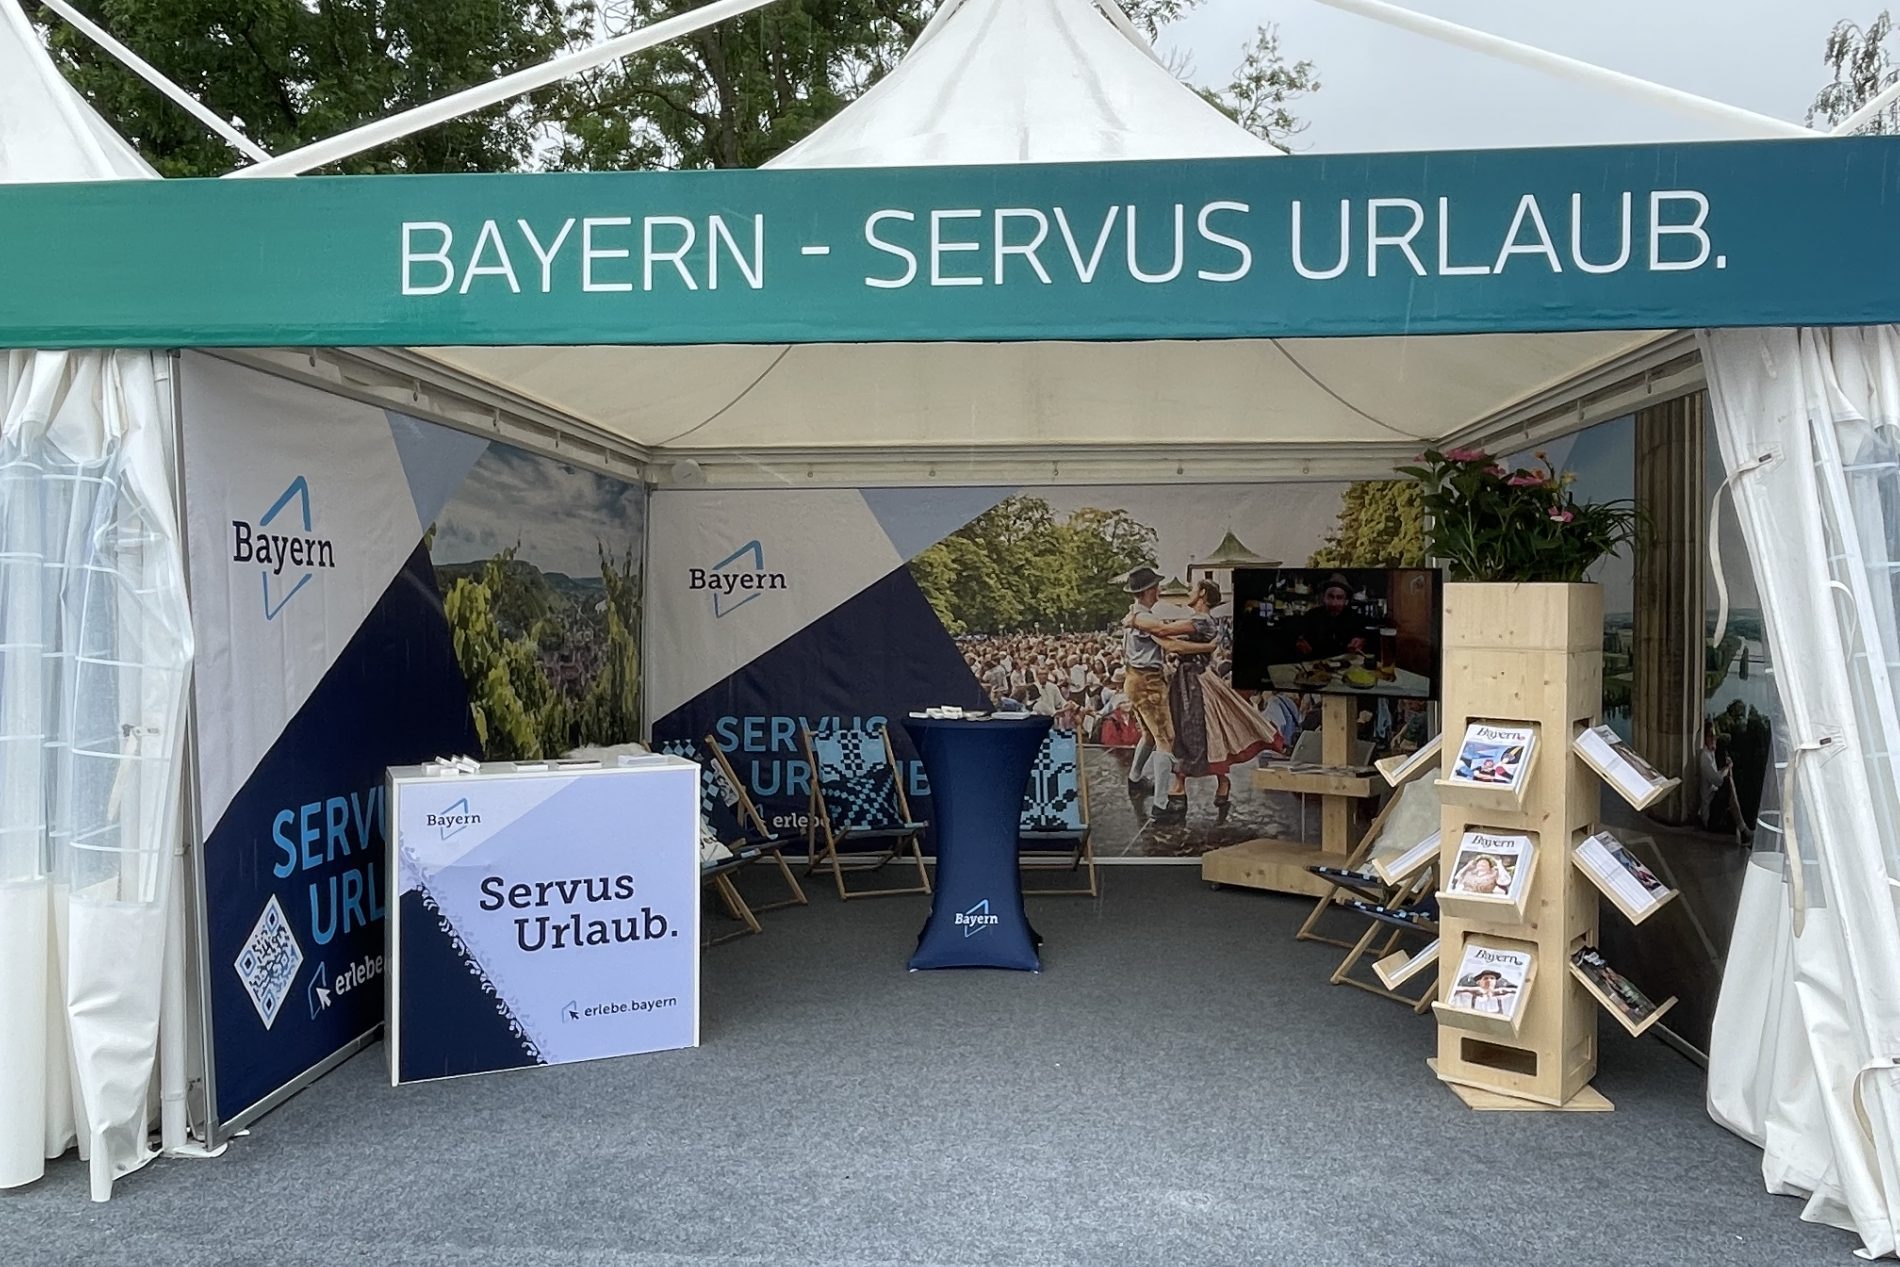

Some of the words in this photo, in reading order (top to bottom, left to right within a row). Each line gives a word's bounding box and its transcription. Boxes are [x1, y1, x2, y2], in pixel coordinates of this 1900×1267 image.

[401, 214, 764, 296] BAYERN
[801, 246, 830, 255] -
[864, 200, 1252, 289] SERVUS
[1291, 189, 1728, 281] URLAUB.
[232, 520, 335, 575] Bayern
[688, 568, 787, 596] Bayern
[272, 785, 386, 879] SERV
[426, 814, 481, 829] Bayern
[309, 862, 386, 945] URL
[479, 874, 634, 911] Servus
[514, 907, 678, 952] Urlaub.
[954, 912, 999, 927] Bayern
[584, 997, 677, 1017] erlebe.bayern
